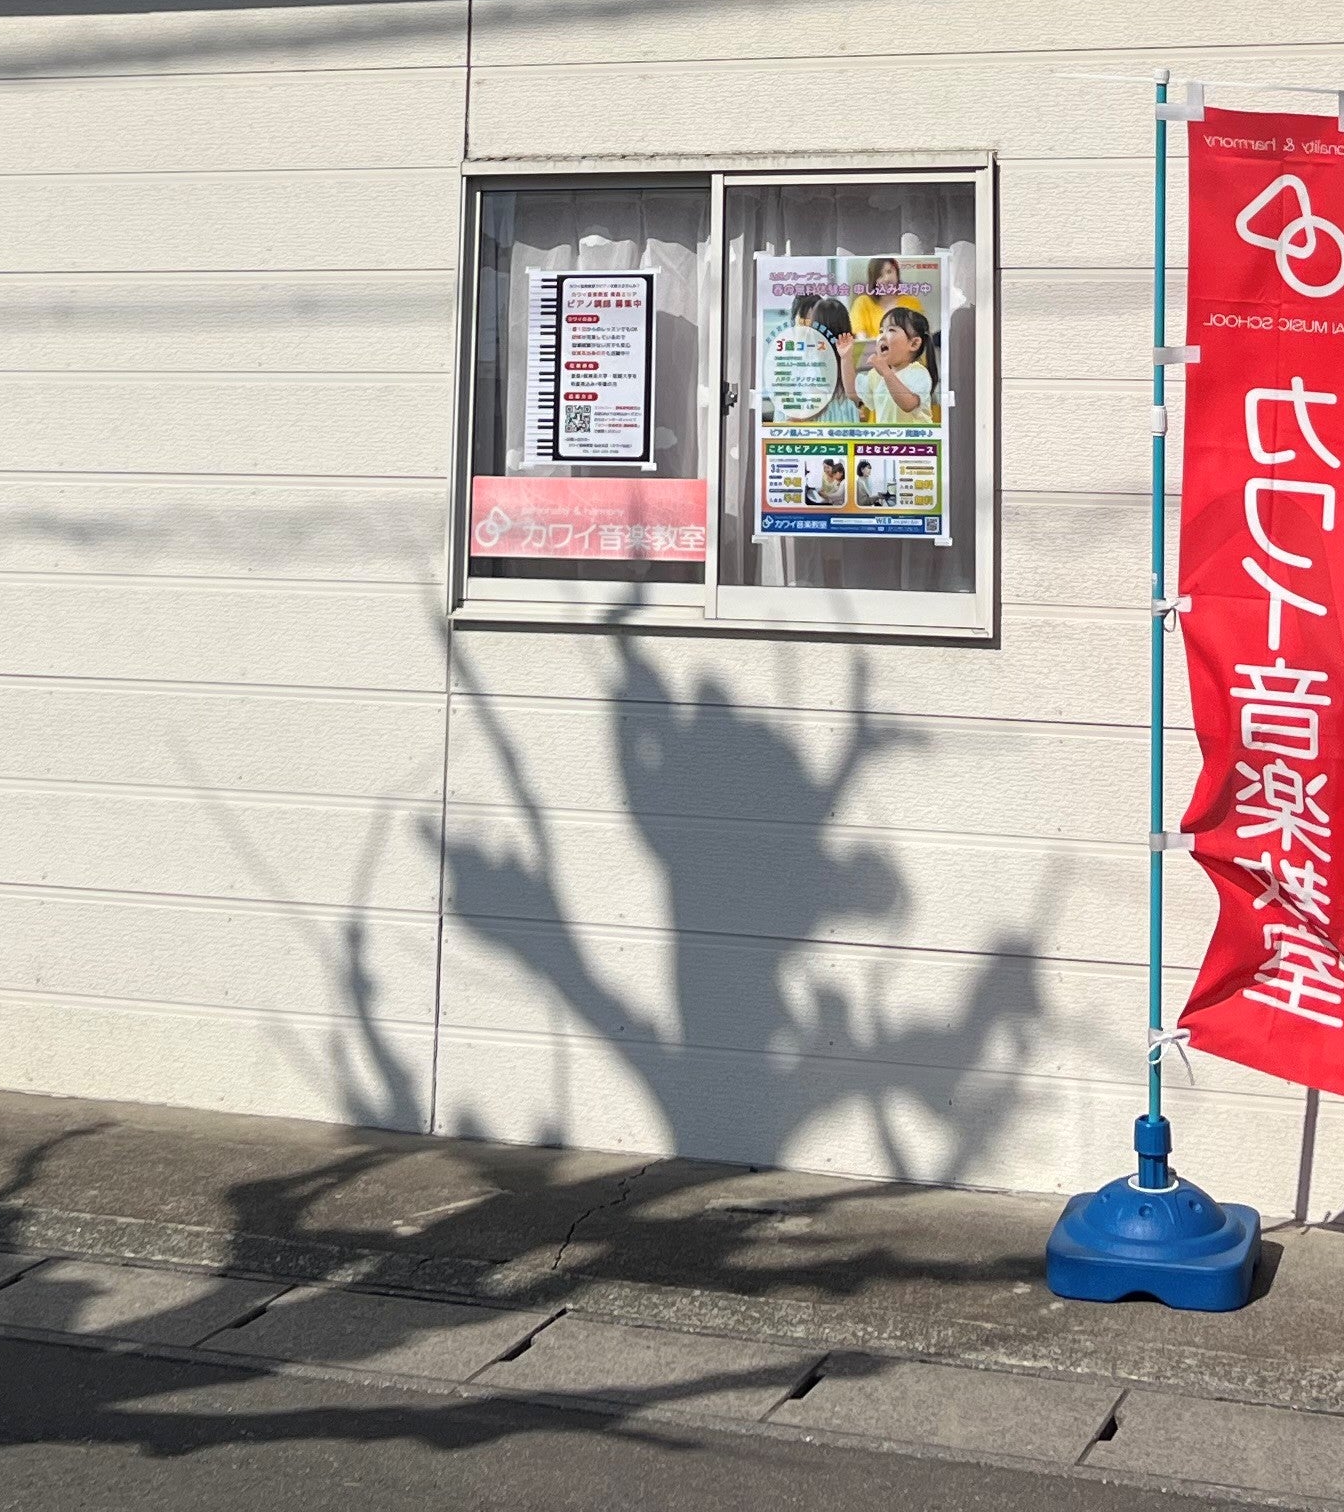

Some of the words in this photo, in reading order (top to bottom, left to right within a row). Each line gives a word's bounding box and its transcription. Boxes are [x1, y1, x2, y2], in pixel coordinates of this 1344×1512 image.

[769, 445, 844, 453] こどもピアノコース
[522, 523, 706, 552] カワイ音楽教室
